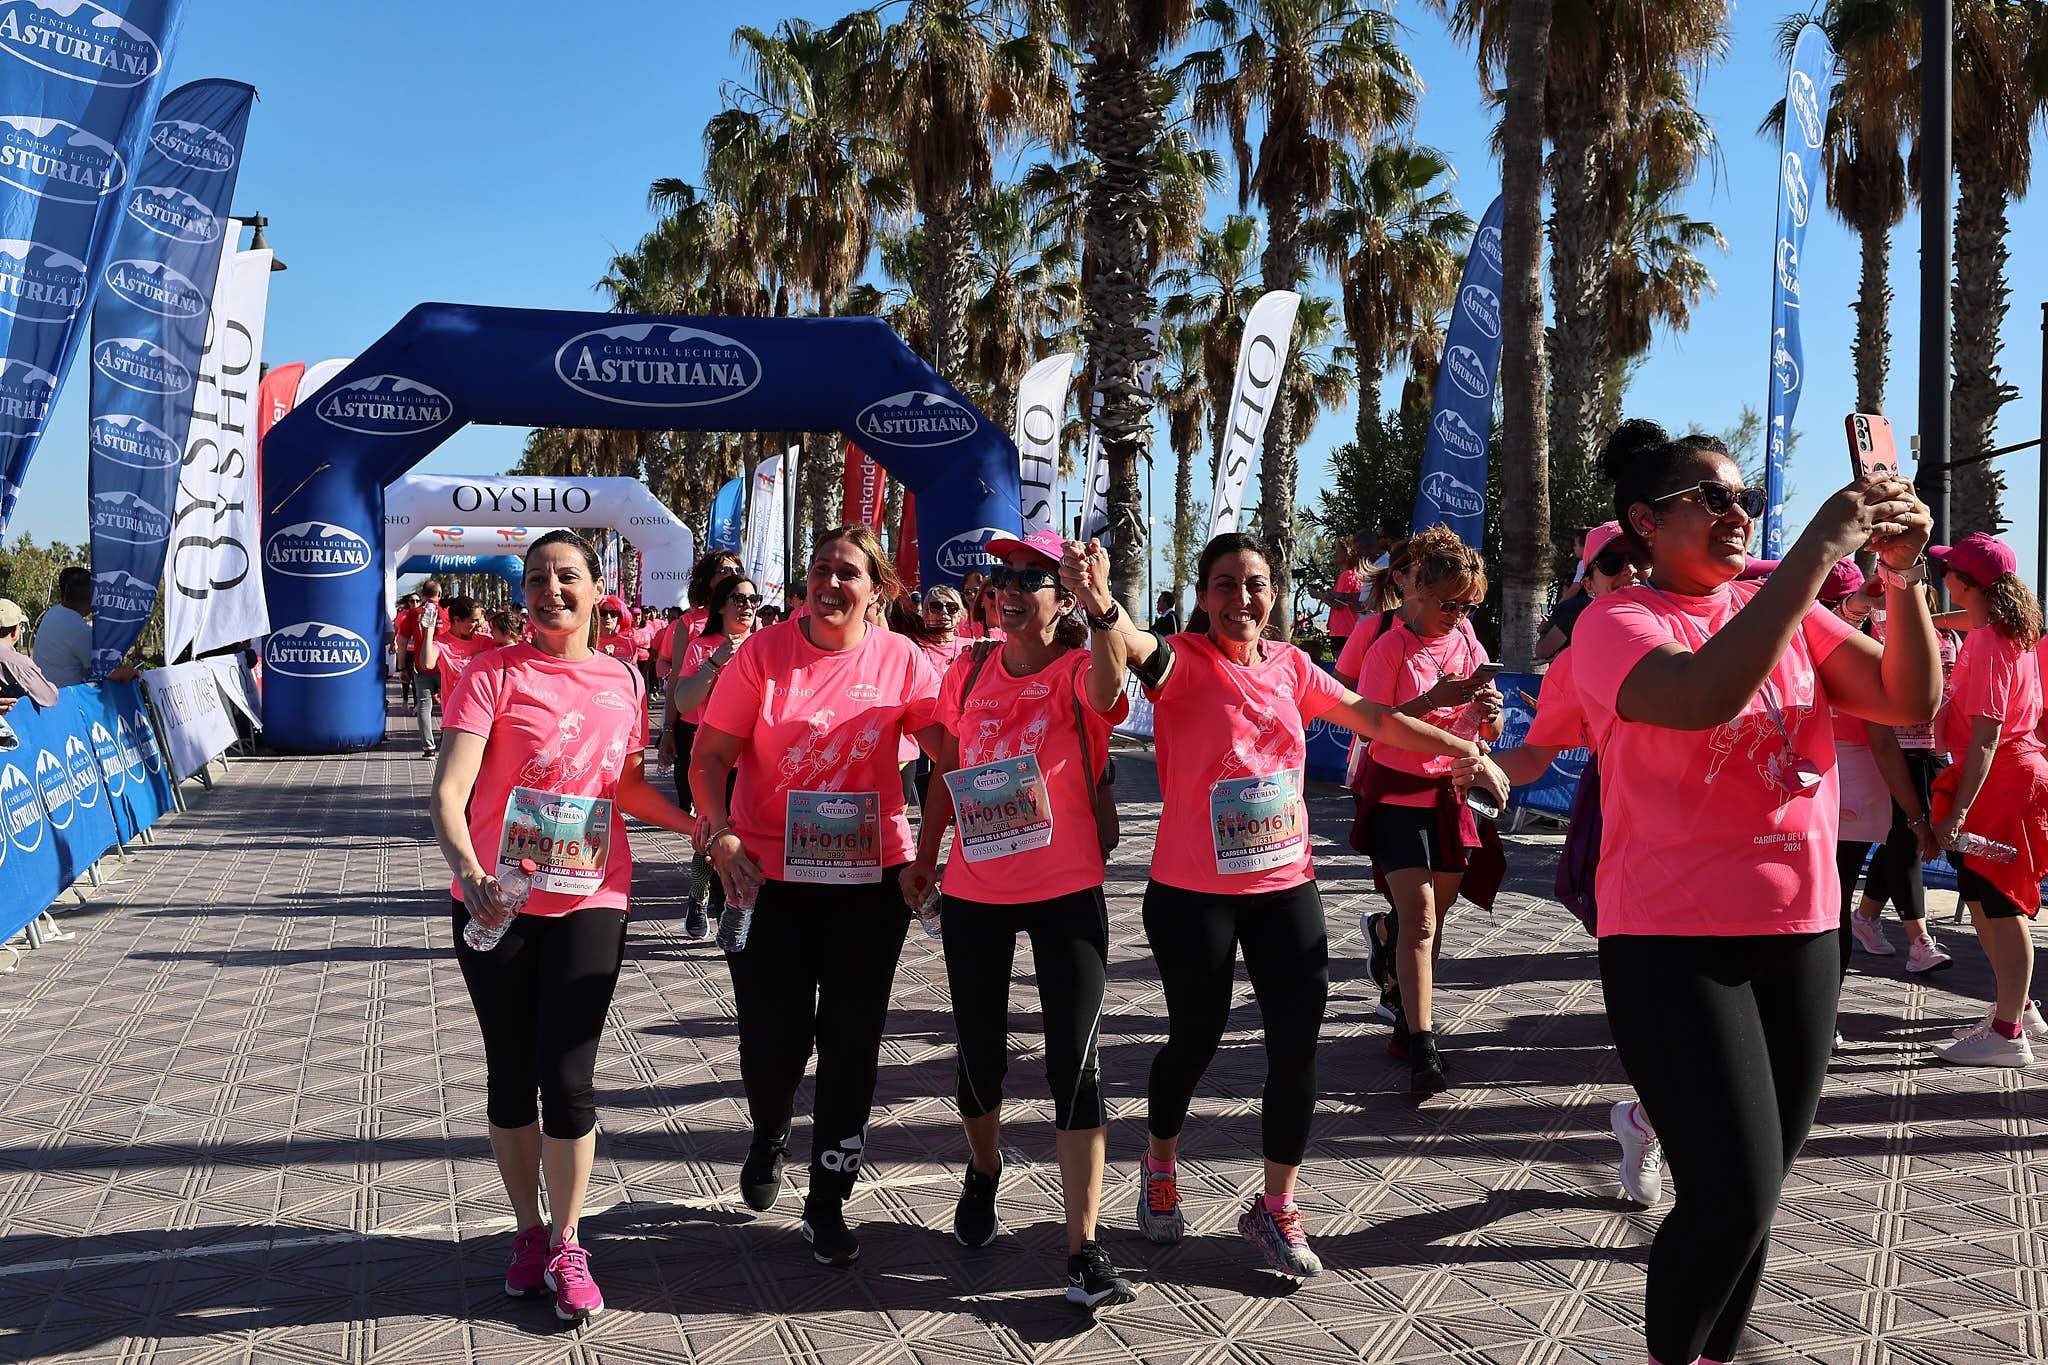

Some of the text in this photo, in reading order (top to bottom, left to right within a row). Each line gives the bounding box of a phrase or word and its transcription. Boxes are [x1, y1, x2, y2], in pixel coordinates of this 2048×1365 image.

[0, 9, 148, 76] ASTURIANA
[29, 13, 149, 54] CENTRAL LECHERA
[6, 133, 65, 157] CENTRAL
[129, 193, 212, 239] ASTURIANA
[112, 267, 197, 313] ASTURIANA
[603, 345, 740, 359] CENTRAL LECHERA
[99, 346, 183, 389] ASTURIANA
[571, 345, 747, 387] ASTURIANA
[324, 396, 443, 421] ASTURIANA
[867, 413, 972, 433] ASTURIANA
[1217, 334, 1277, 523] YSHO
[92, 425, 173, 463] ASTURIANA
[1023, 404, 1055, 525] SHO
[452, 485, 592, 514] OYSHO
[860, 453, 877, 529] antande
[97, 512, 164, 537] STURIANA
[385, 514, 410, 525] SHO
[630, 516, 670, 526] OYSHO
[270, 542, 365, 565] ASTURIANA
[323, 540, 362, 548] LECHERA
[430, 554, 478, 571] Marlene
[269, 641, 364, 664] ASTURIANA
[321, 640, 360, 648] LECHERA
[774, 687, 815, 698] OYSHO
[968, 699, 998, 708] YSHO
[983, 801, 1017, 822] 016
[1247, 814, 1283, 835] 016
[539, 837, 580, 856] 016
[820, 832, 857, 849] 016
[1753, 833, 1786, 844] CARRERA
[1787, 832, 1797, 841] DE
[1798, 832, 1807, 841] LA
[1783, 842, 1801, 852] 2024
[972, 844, 1000, 857] OYSHO
[1221, 847, 1248, 858] CARRERA
[504, 858, 521, 867] CARR
[541, 865, 550, 873] LA
[550, 867, 571, 876] MUJER
[790, 858, 815, 866] CARRERA
[1228, 858, 1261, 869] OYSHO
[795, 869, 828, 878] OYSHO
